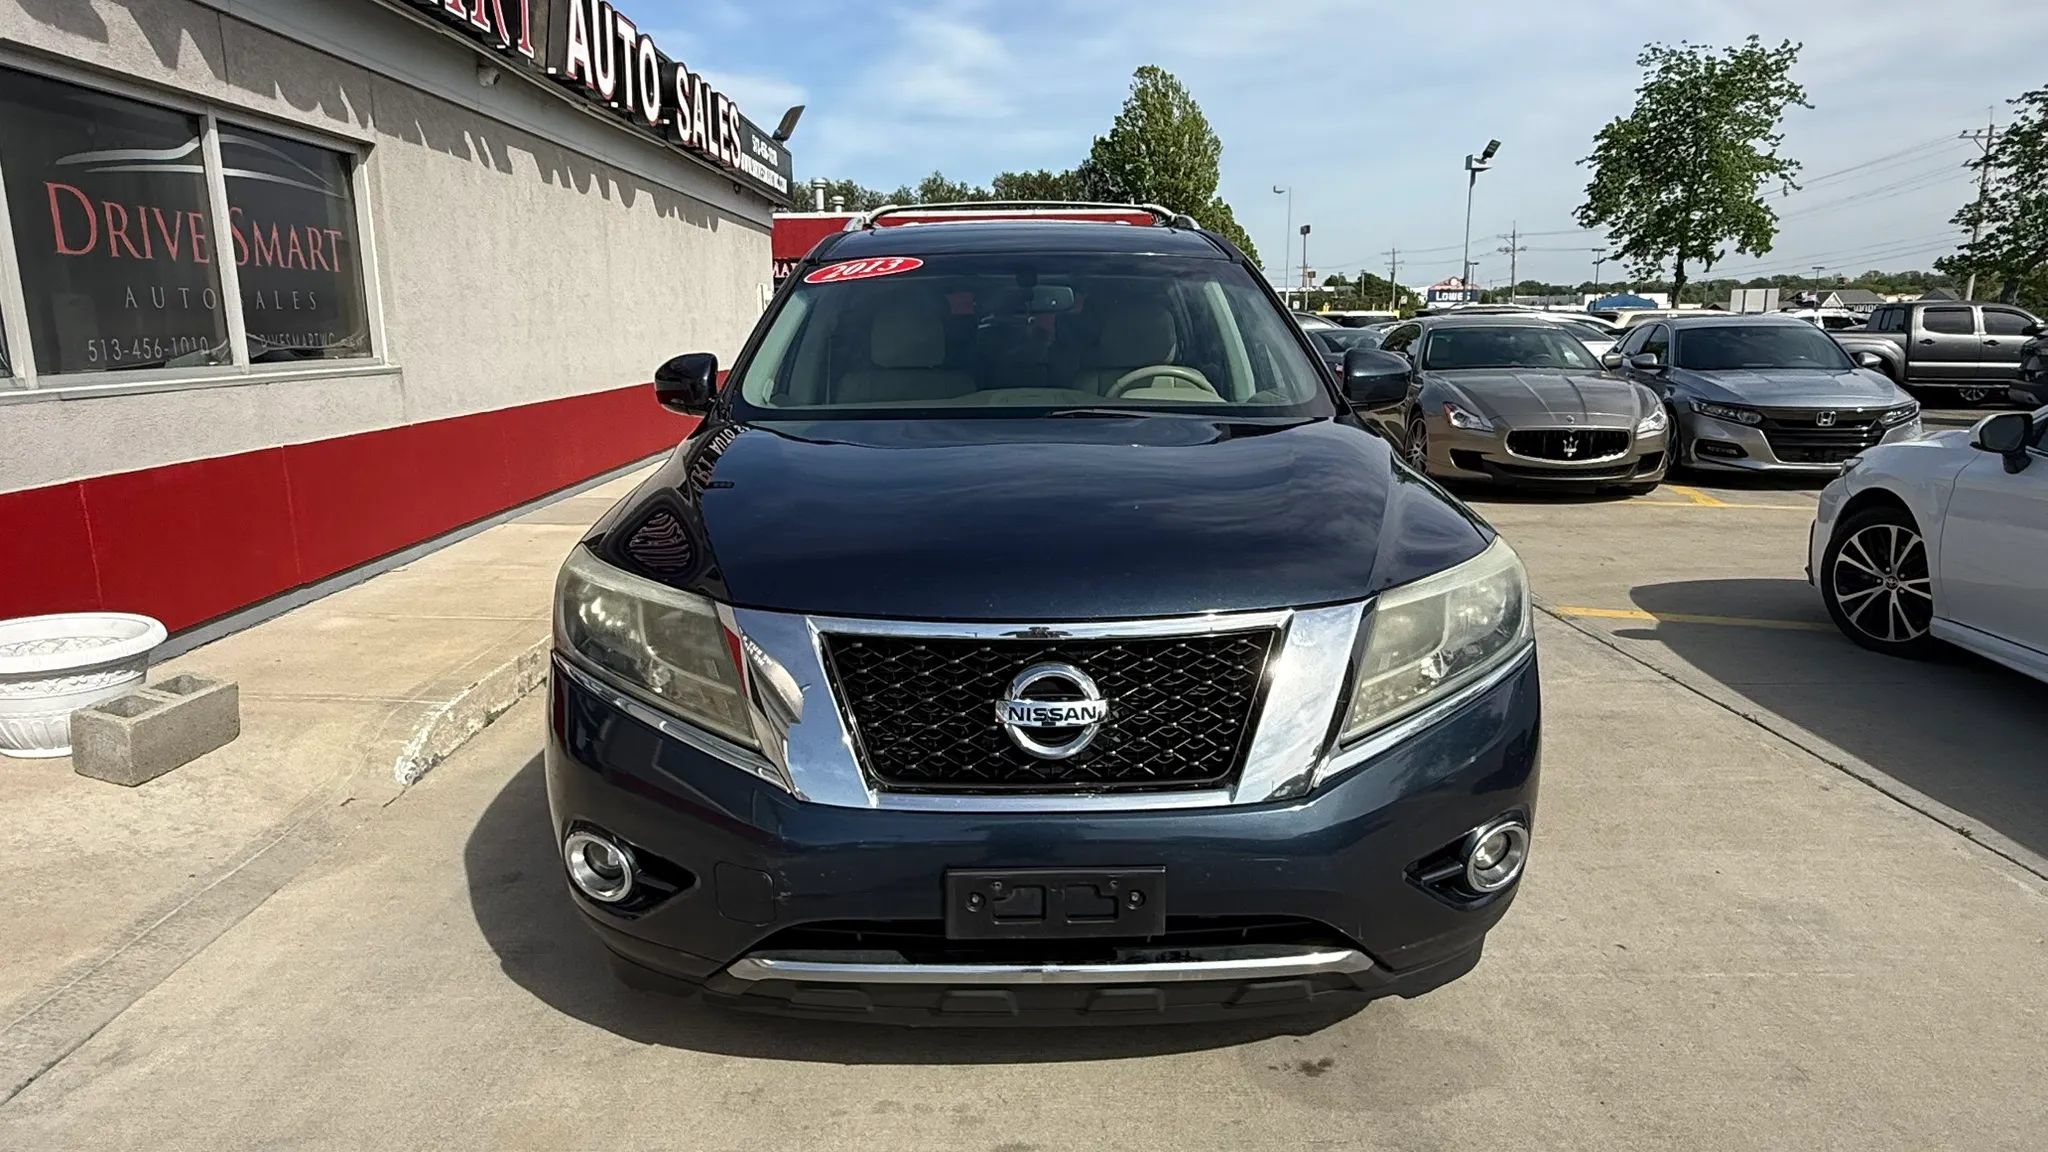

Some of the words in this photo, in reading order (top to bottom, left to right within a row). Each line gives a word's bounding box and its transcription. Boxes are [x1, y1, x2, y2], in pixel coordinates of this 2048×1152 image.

[566, 0, 660, 125] AUTO
[676, 64, 741, 168] SALES
[44, 181, 209, 264] DRIVE
[229, 206, 342, 272] SMART
[821, 257, 904, 280] 2013
[125, 286, 217, 310] AUTO
[241, 290, 317, 310] ALES
[1435, 290, 1471, 301] LOWES
[1008, 706, 1096, 722] NISSAN
